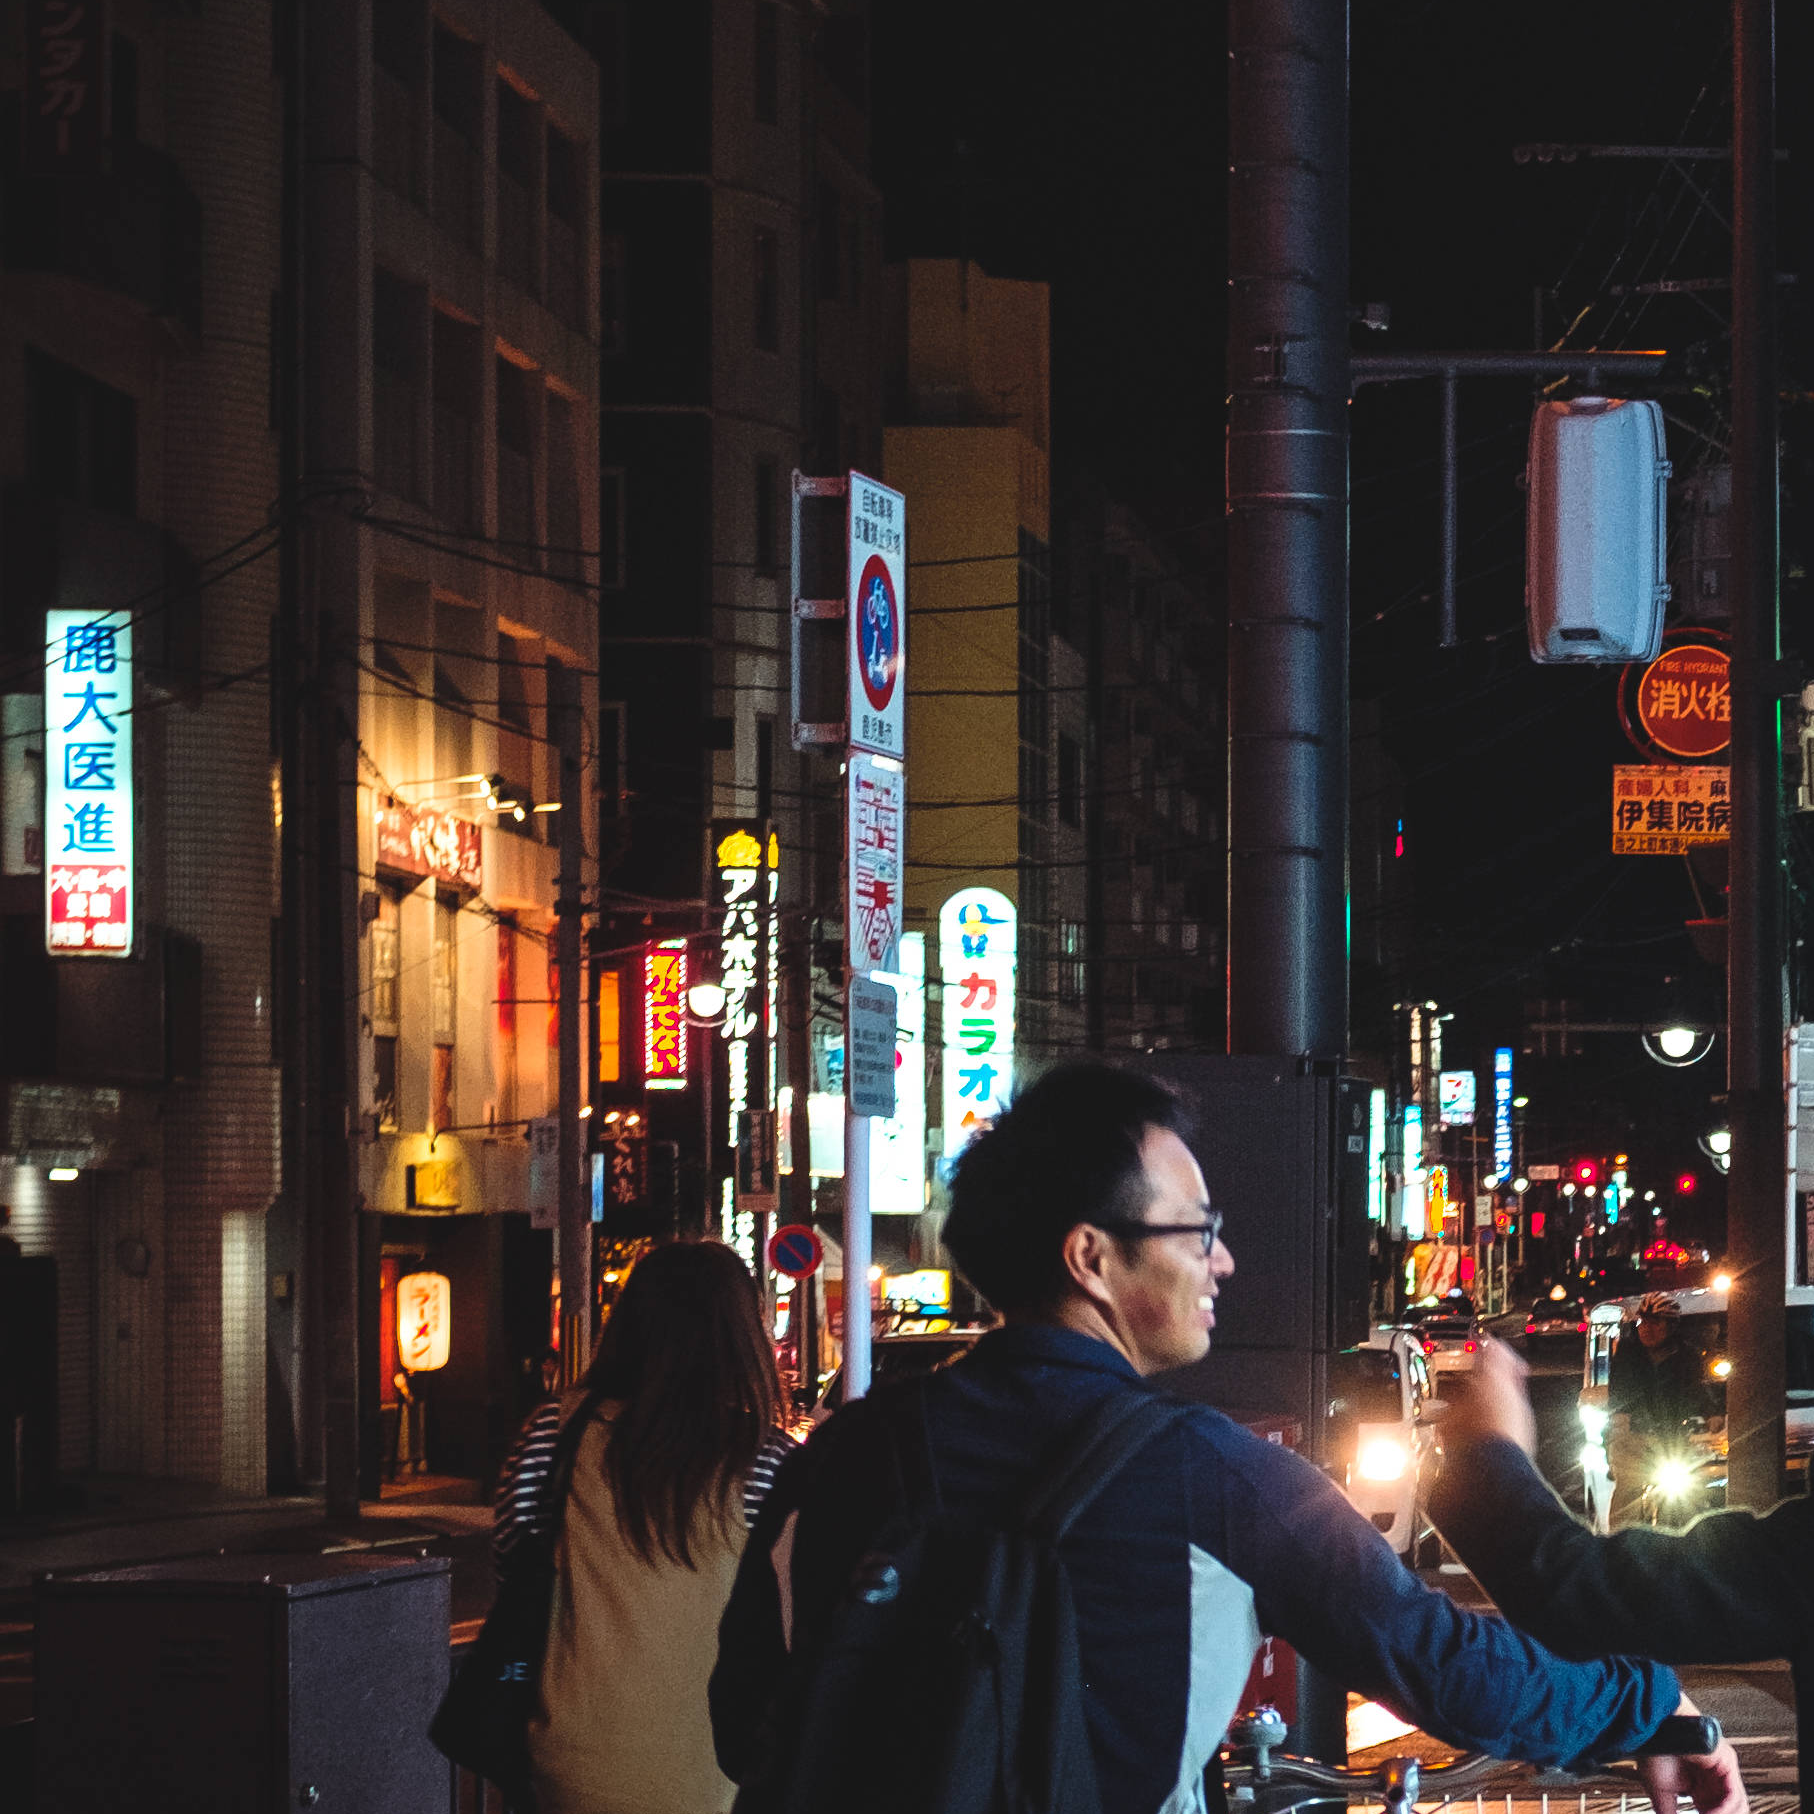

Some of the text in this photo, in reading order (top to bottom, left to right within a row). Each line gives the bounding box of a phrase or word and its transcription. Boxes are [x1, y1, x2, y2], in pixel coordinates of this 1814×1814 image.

[1659, 659, 1729, 676] FIRE HYDRANT
[62, 625, 118, 854] 鹿大医進
[720, 869, 758, 1038] アパホテル
[410, 1287, 432, 1359] ラーメン
